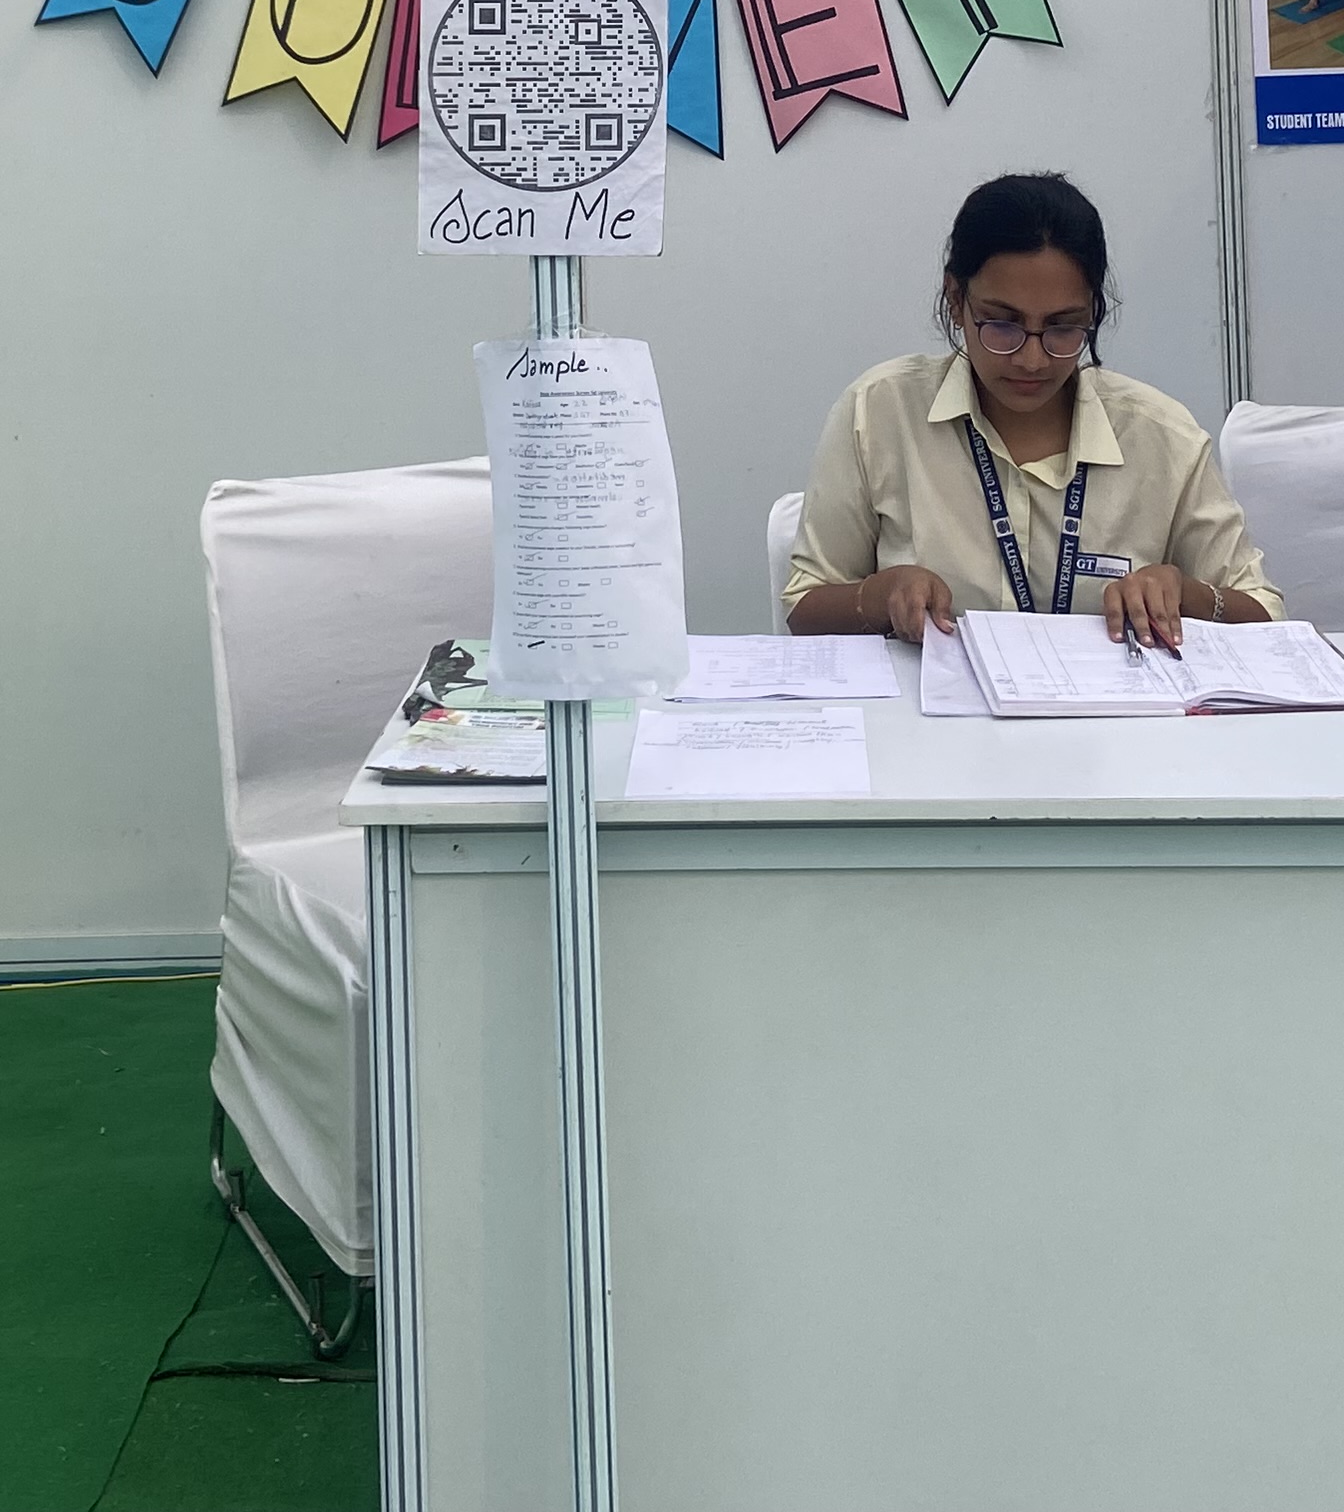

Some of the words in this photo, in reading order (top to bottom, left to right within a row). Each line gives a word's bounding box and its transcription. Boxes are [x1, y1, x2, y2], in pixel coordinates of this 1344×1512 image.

[1267, 113, 1313, 129] STUDENT
[1316, 112, 1344, 128] TEAM
[430, 189, 535, 243] Scan
[565, 188, 635, 240] Me
[970, 424, 996, 488] UNIVERSIT
[988, 489, 1003, 512] SGT
[1069, 488, 1081, 511] SGT
[1003, 540, 1030, 609] UNIVERSITY
[1057, 540, 1075, 608] UNIVERSITY
[1077, 558, 1095, 571] GT
